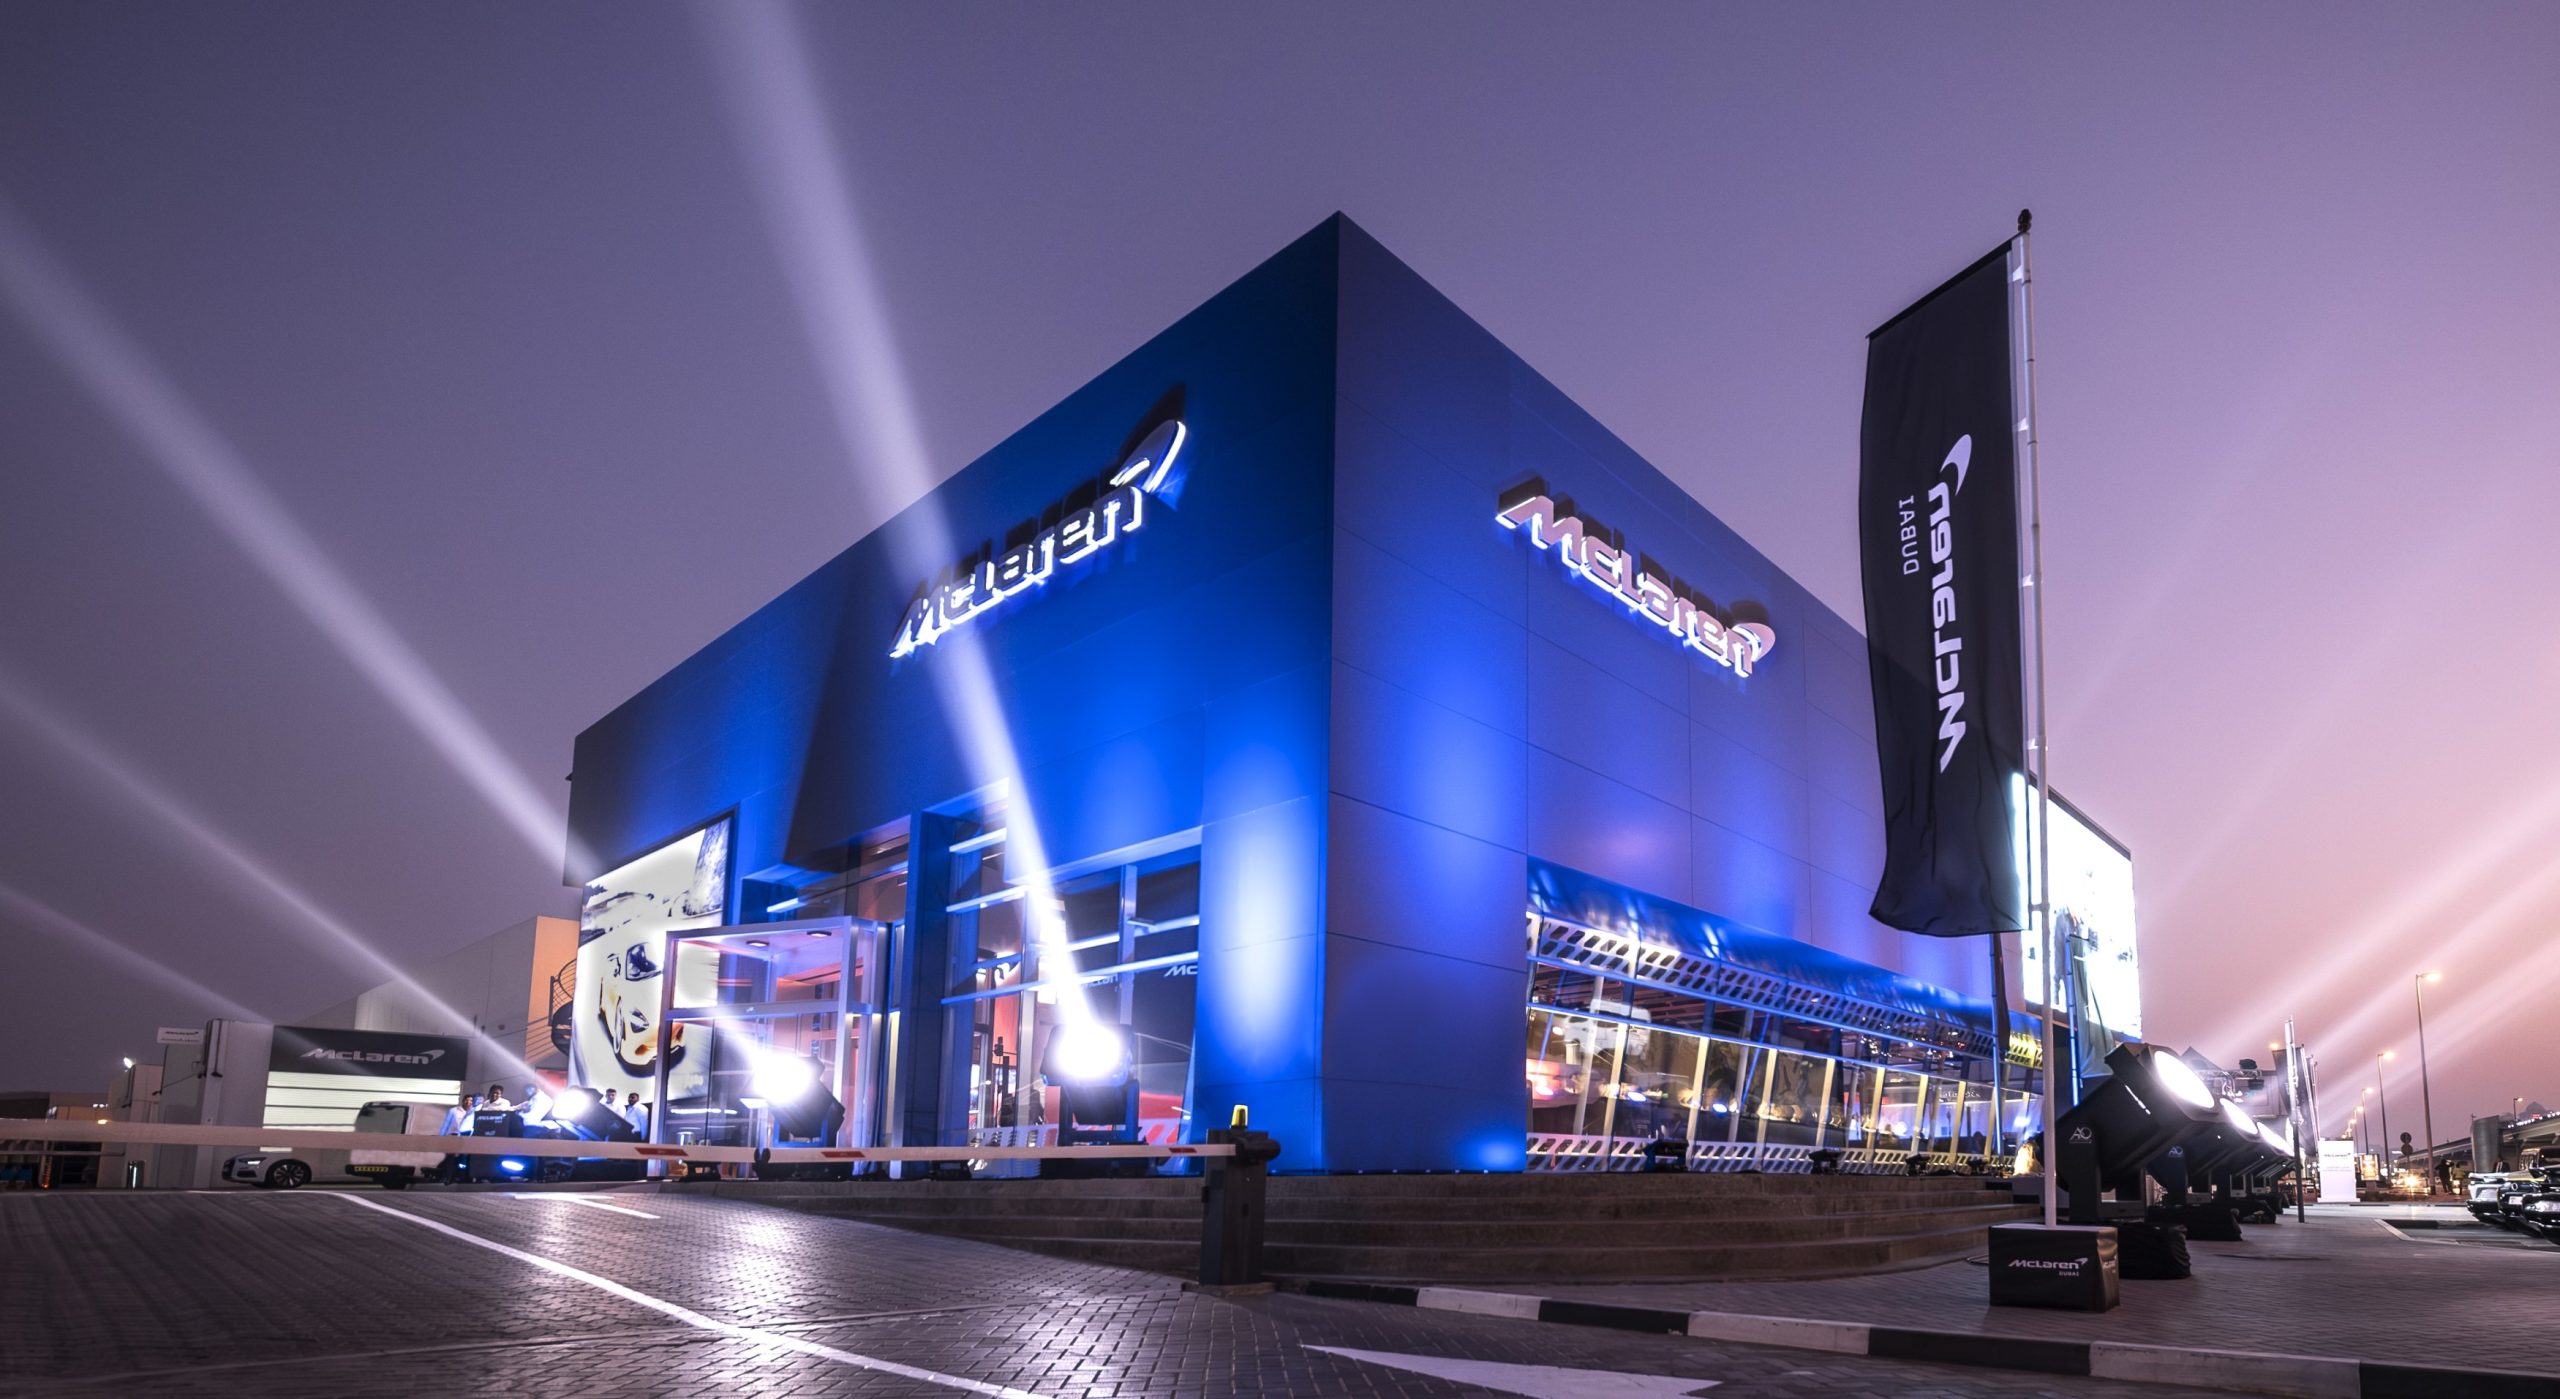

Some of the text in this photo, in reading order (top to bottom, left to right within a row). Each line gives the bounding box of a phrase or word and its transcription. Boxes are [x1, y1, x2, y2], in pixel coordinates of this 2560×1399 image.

[889, 486, 1143, 658] McLaren
[1495, 496, 1752, 678] McLaren
[300, 1048, 429, 1064] McLaren
[2008, 1259, 2080, 1270] McLaren
